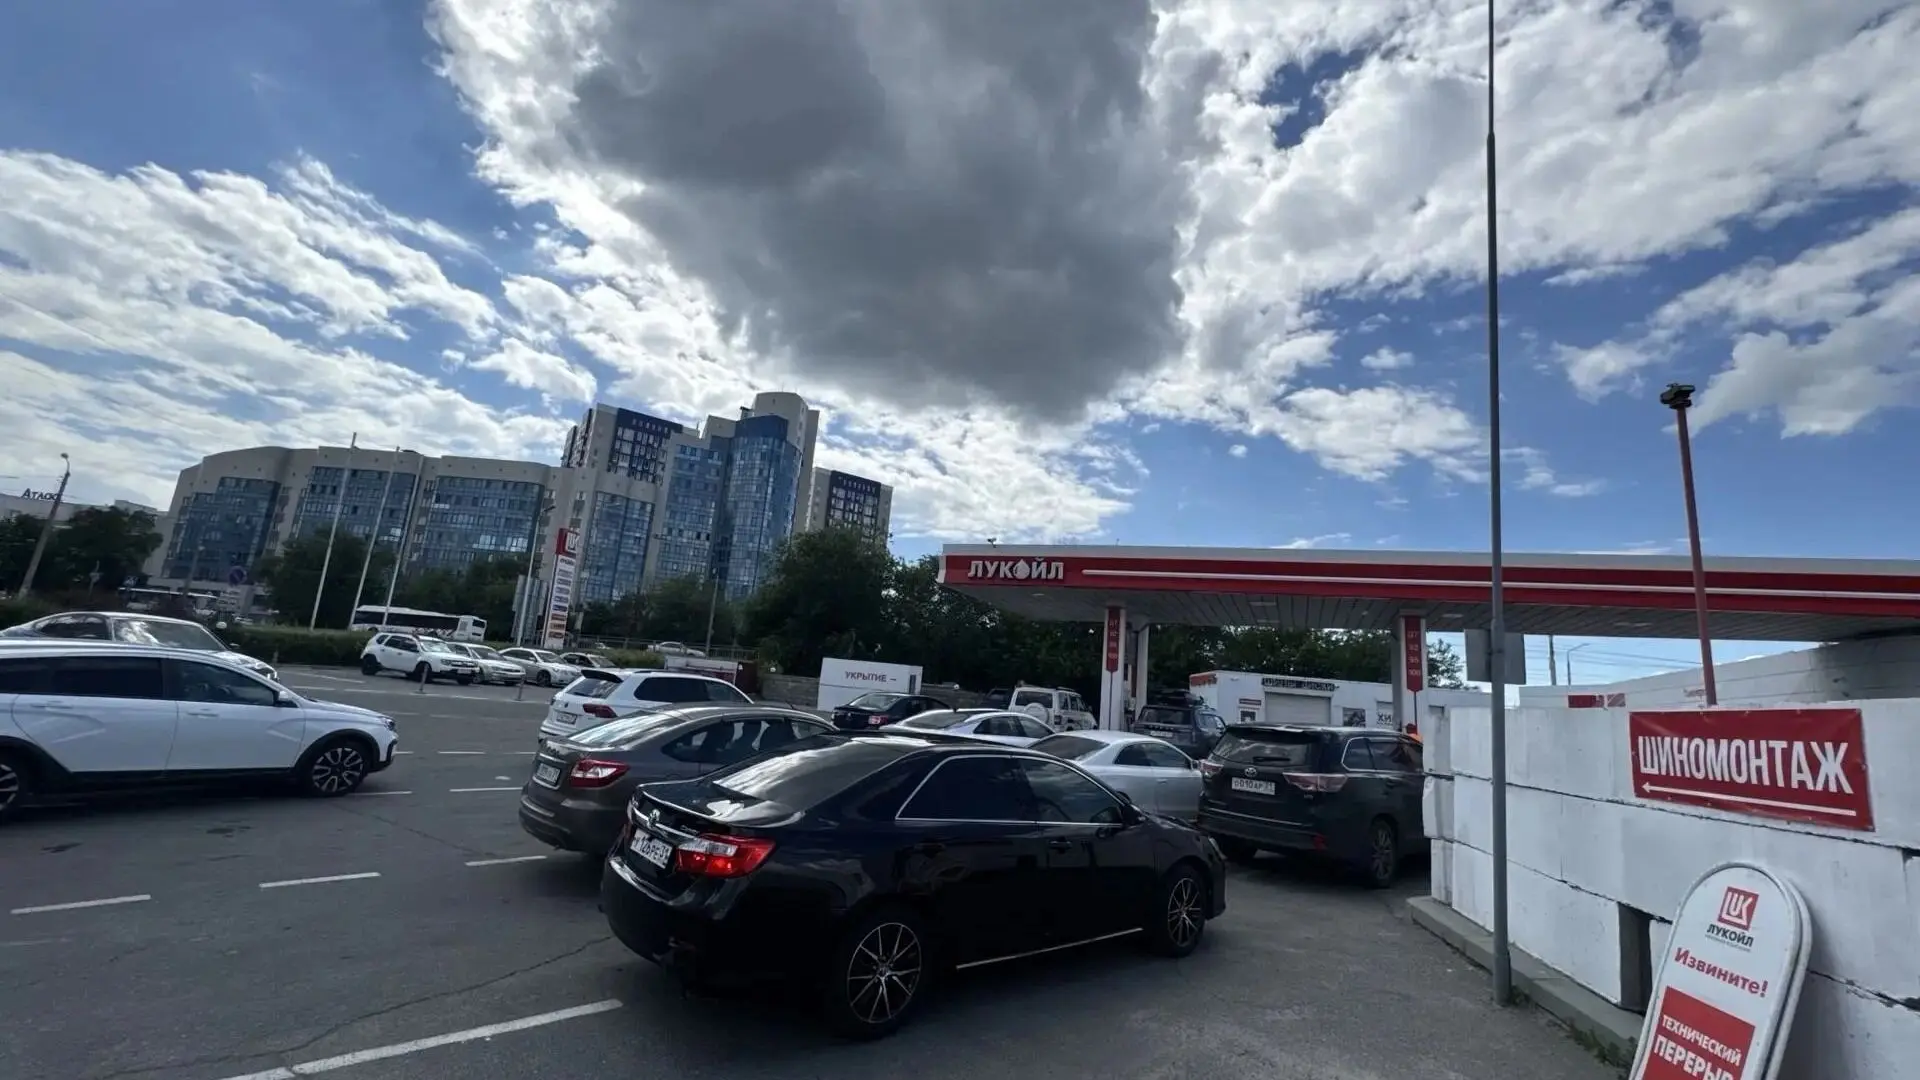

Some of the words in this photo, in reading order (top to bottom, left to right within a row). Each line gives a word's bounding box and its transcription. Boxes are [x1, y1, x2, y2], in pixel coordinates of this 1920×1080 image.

[968, 557, 1064, 579] ЛУКОЙЛ
[844, 671, 887, 682] УКРЫТИЕ
[1638, 736, 1853, 794] ШИНОМОНТАЖ
[1707, 923, 1754, 947] ЛУКОЙЛ
[1674, 947, 1768, 998] Извините!
[1662, 1014, 1742, 1066] ТЕХНИЧЕСКИЙ
